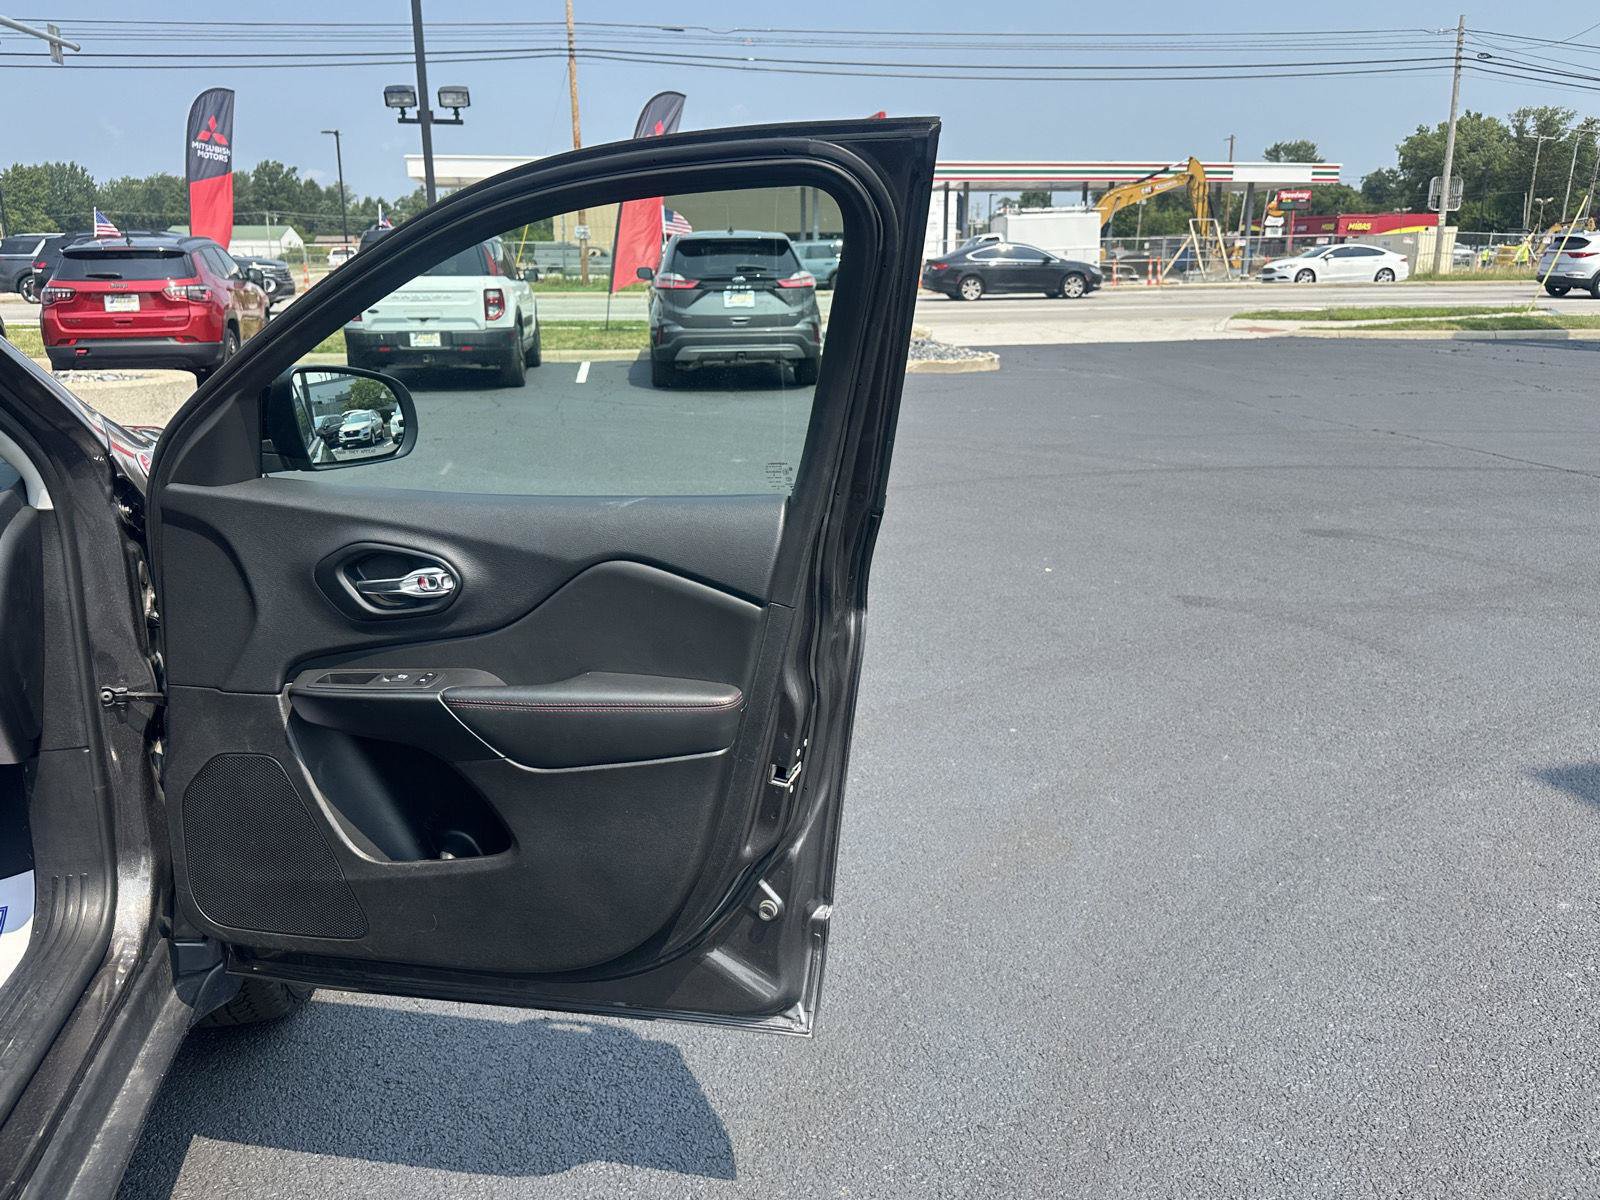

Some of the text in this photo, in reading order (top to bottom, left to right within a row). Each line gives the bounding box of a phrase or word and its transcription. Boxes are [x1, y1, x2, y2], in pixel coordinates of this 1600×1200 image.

[191, 141, 231, 156] MITSUBISH
[197, 149, 228, 163] MOTORS
[1280, 191, 1310, 199] Speedway
